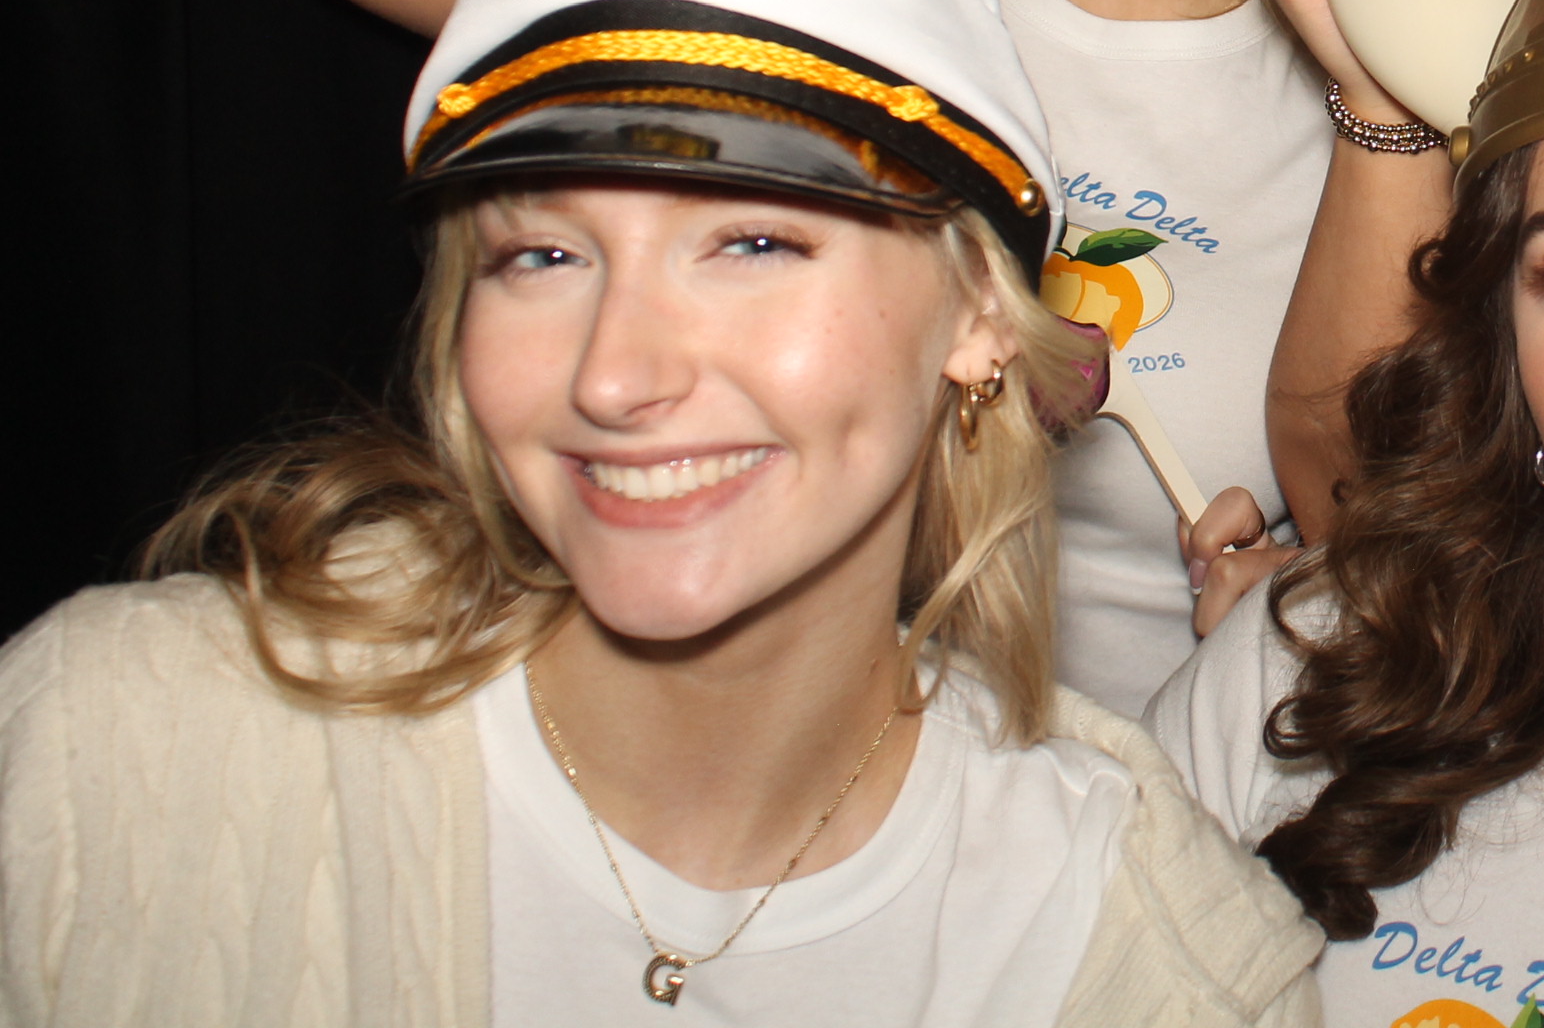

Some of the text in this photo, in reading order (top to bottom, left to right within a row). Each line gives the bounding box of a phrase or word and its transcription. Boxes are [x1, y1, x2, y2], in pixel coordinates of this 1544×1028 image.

[1125, 190, 1220, 253] Delta
[1127, 352, 1186, 373] 2026
[642, 954, 685, 1007] G
[1372, 921, 1503, 992] Delta
